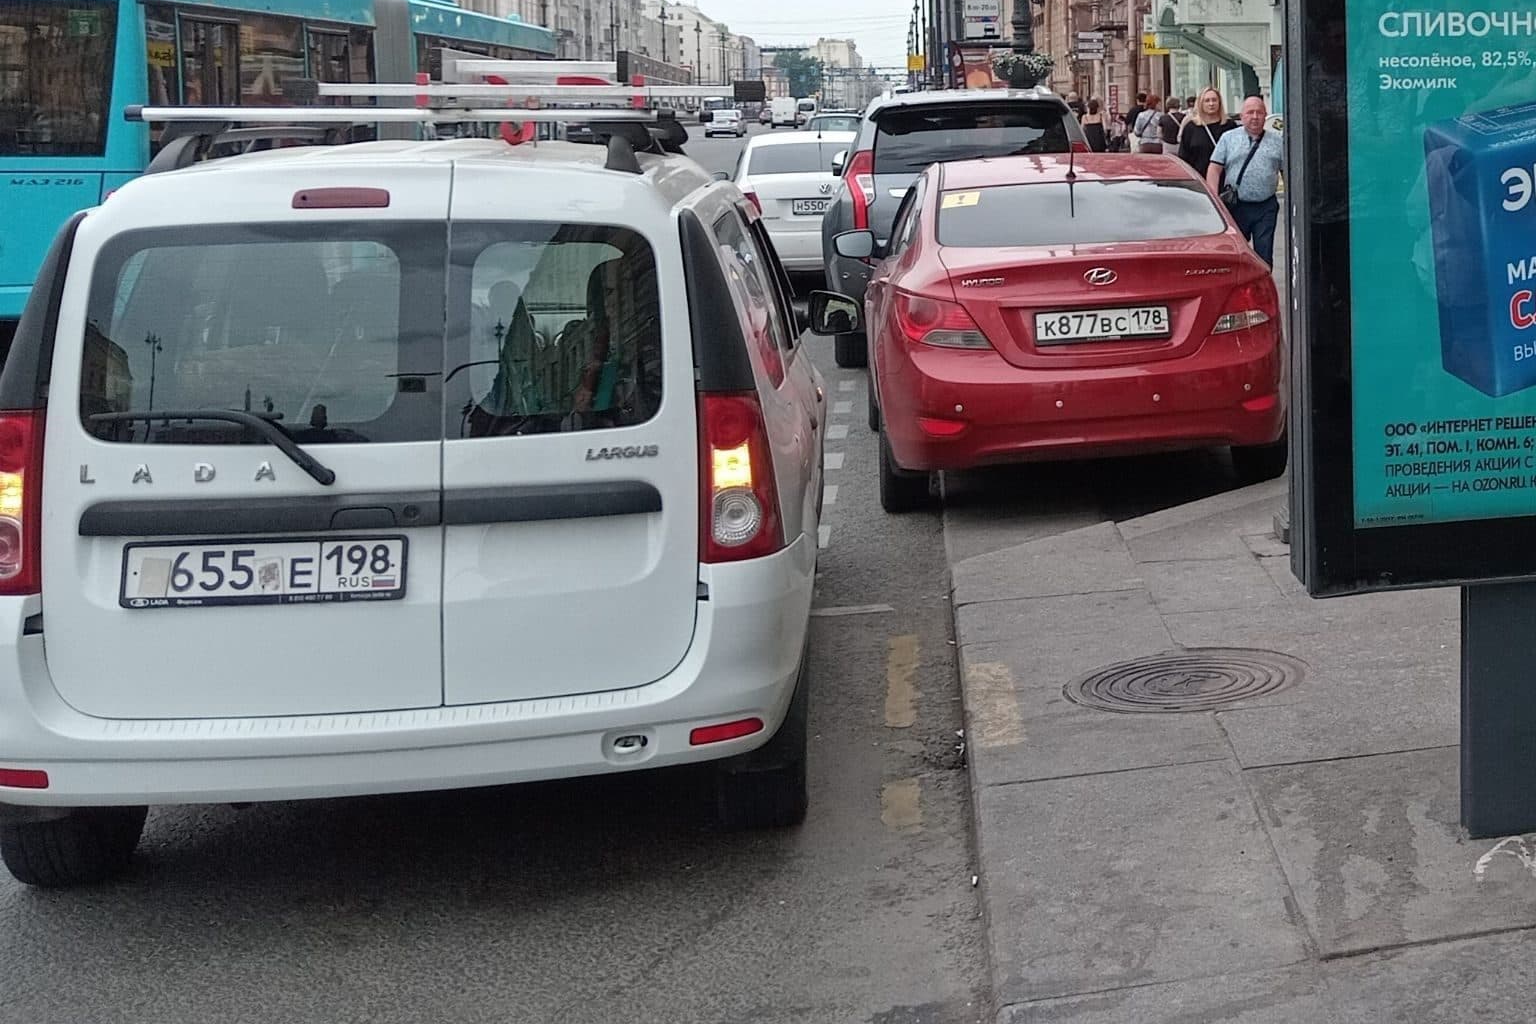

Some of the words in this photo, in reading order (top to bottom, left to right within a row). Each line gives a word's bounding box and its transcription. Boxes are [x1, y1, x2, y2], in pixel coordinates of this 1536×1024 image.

[1379, 51, 1475, 68] несолёное,
[1482, 51, 1536, 69] 82,5%,
[1379, 74, 1457, 90] Экомилк
[1131, 309, 1162, 326] 178
[1385, 423, 1416, 437] ООО
[1420, 418, 1493, 436] «ИНТЕРНЕТ
[585, 444, 659, 461] LARGUS
[1427, 440, 1462, 455] ПОМ.
[1477, 438, 1519, 452] КОМН.
[79, 460, 276, 484] LADA
[1386, 460, 1471, 477] ПРОВЕДЕНИЯ
[1475, 457, 1520, 473] АКЦИИ
[1385, 483, 1430, 498] АКЦИИ
[1452, 480, 1470, 493] НА
[325, 544, 390, 576] 198
[338, 576, 370, 588] RUS
